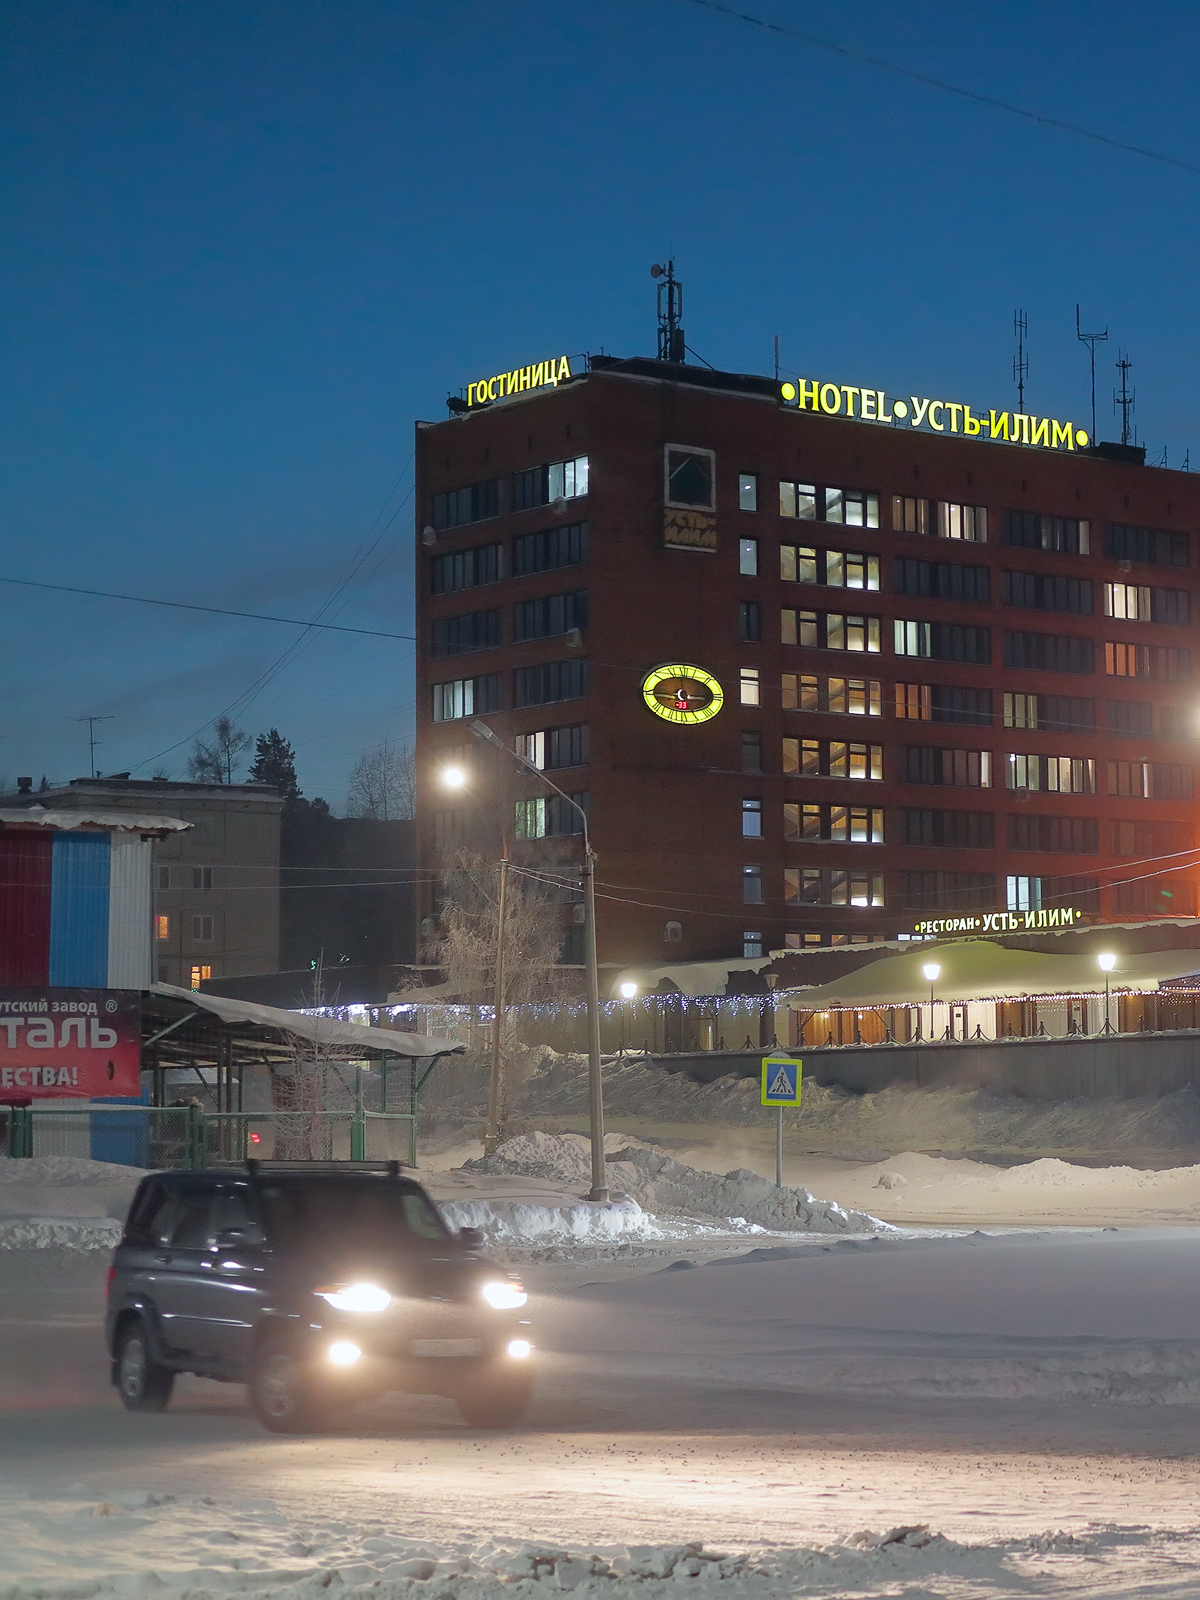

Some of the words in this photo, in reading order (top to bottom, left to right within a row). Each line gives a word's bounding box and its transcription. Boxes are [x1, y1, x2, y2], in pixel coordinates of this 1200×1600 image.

[467, 354, 571, 407] ГОСТИНИЦА
[797, 378, 893, 423] HOTEL
[910, 396, 1075, 451] УСТЬ-ИЛИМ
[920, 917, 975, 934] РЕСТОРАН
[982, 907, 1074, 932] УСТЬ-ИЛИМ
[52, 1002, 98, 1016] завод
